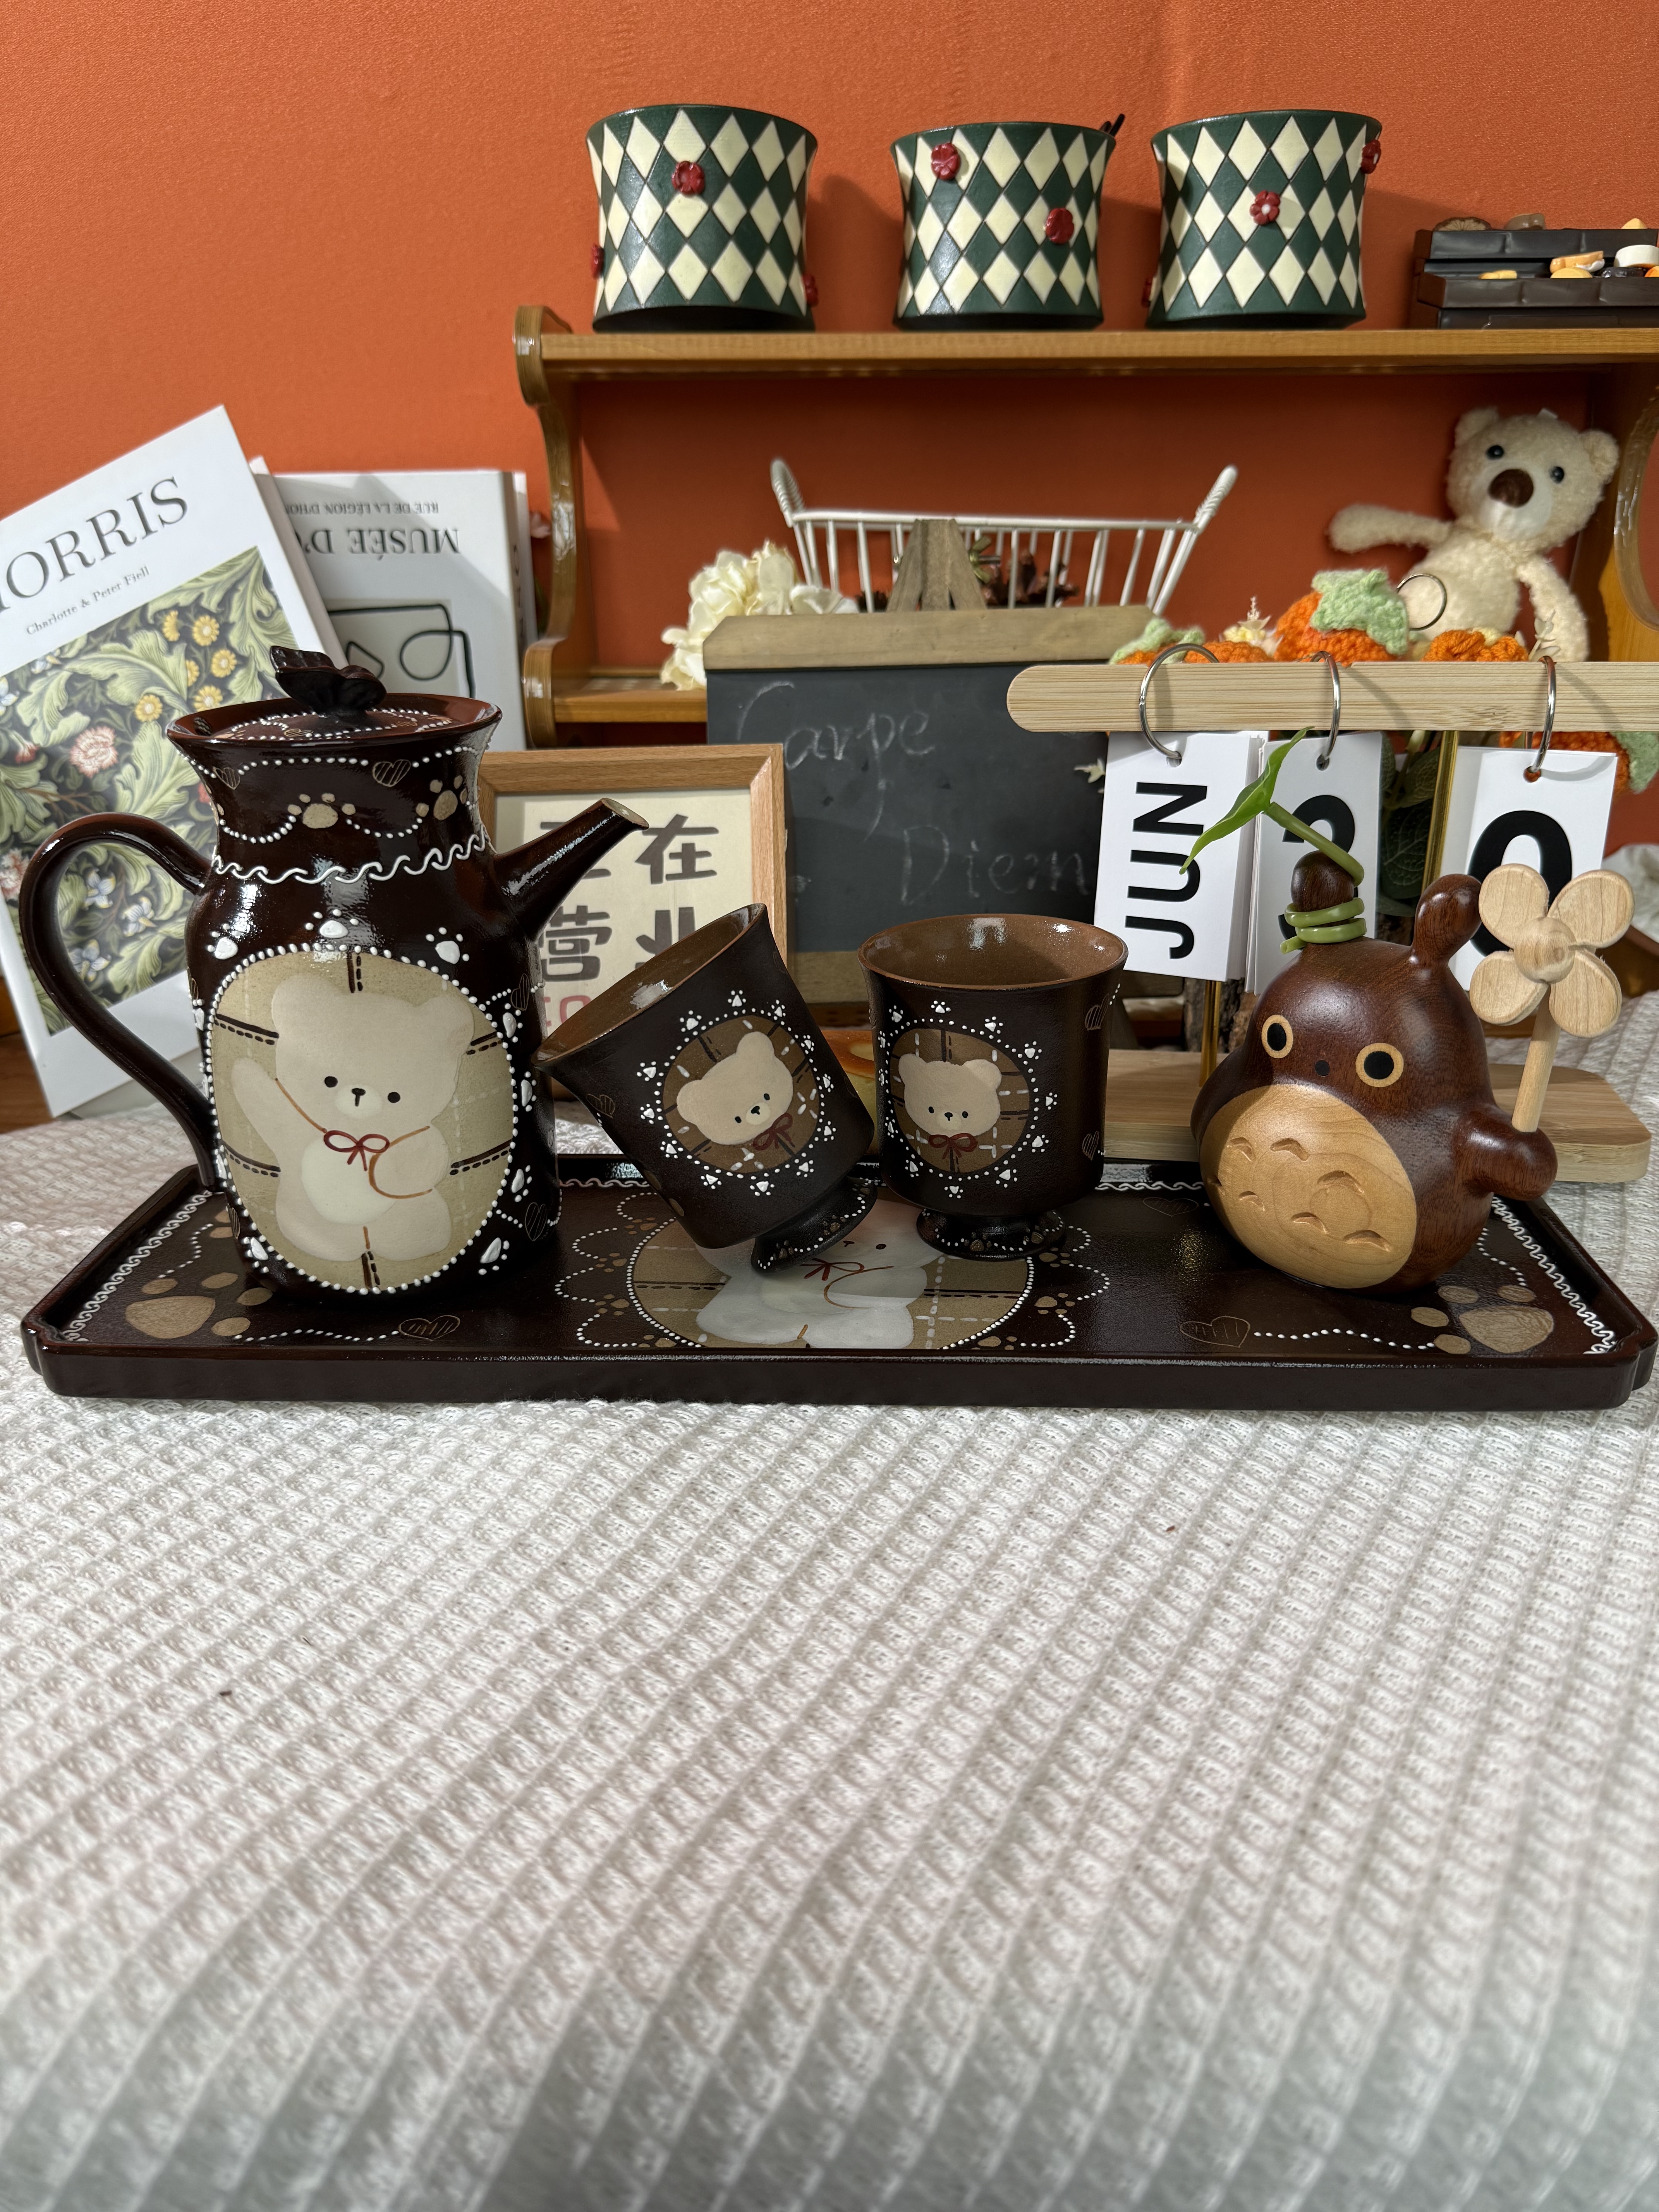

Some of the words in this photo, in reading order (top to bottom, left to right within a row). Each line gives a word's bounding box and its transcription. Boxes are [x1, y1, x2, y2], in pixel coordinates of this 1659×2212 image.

[373, 502, 390, 515] LA
[391, 502, 410, 515] DE
[0, 476, 188, 613] ORRIS
[295, 527, 334, 554] D'
[347, 527, 460, 561] MUSÉE
[26, 605, 79, 635] Charlotte
[81, 598, 91, 608] &
[92, 582, 122, 602] Peter
[123, 566, 150, 586] Fiell
[1125, 782, 1207, 960] JUN
